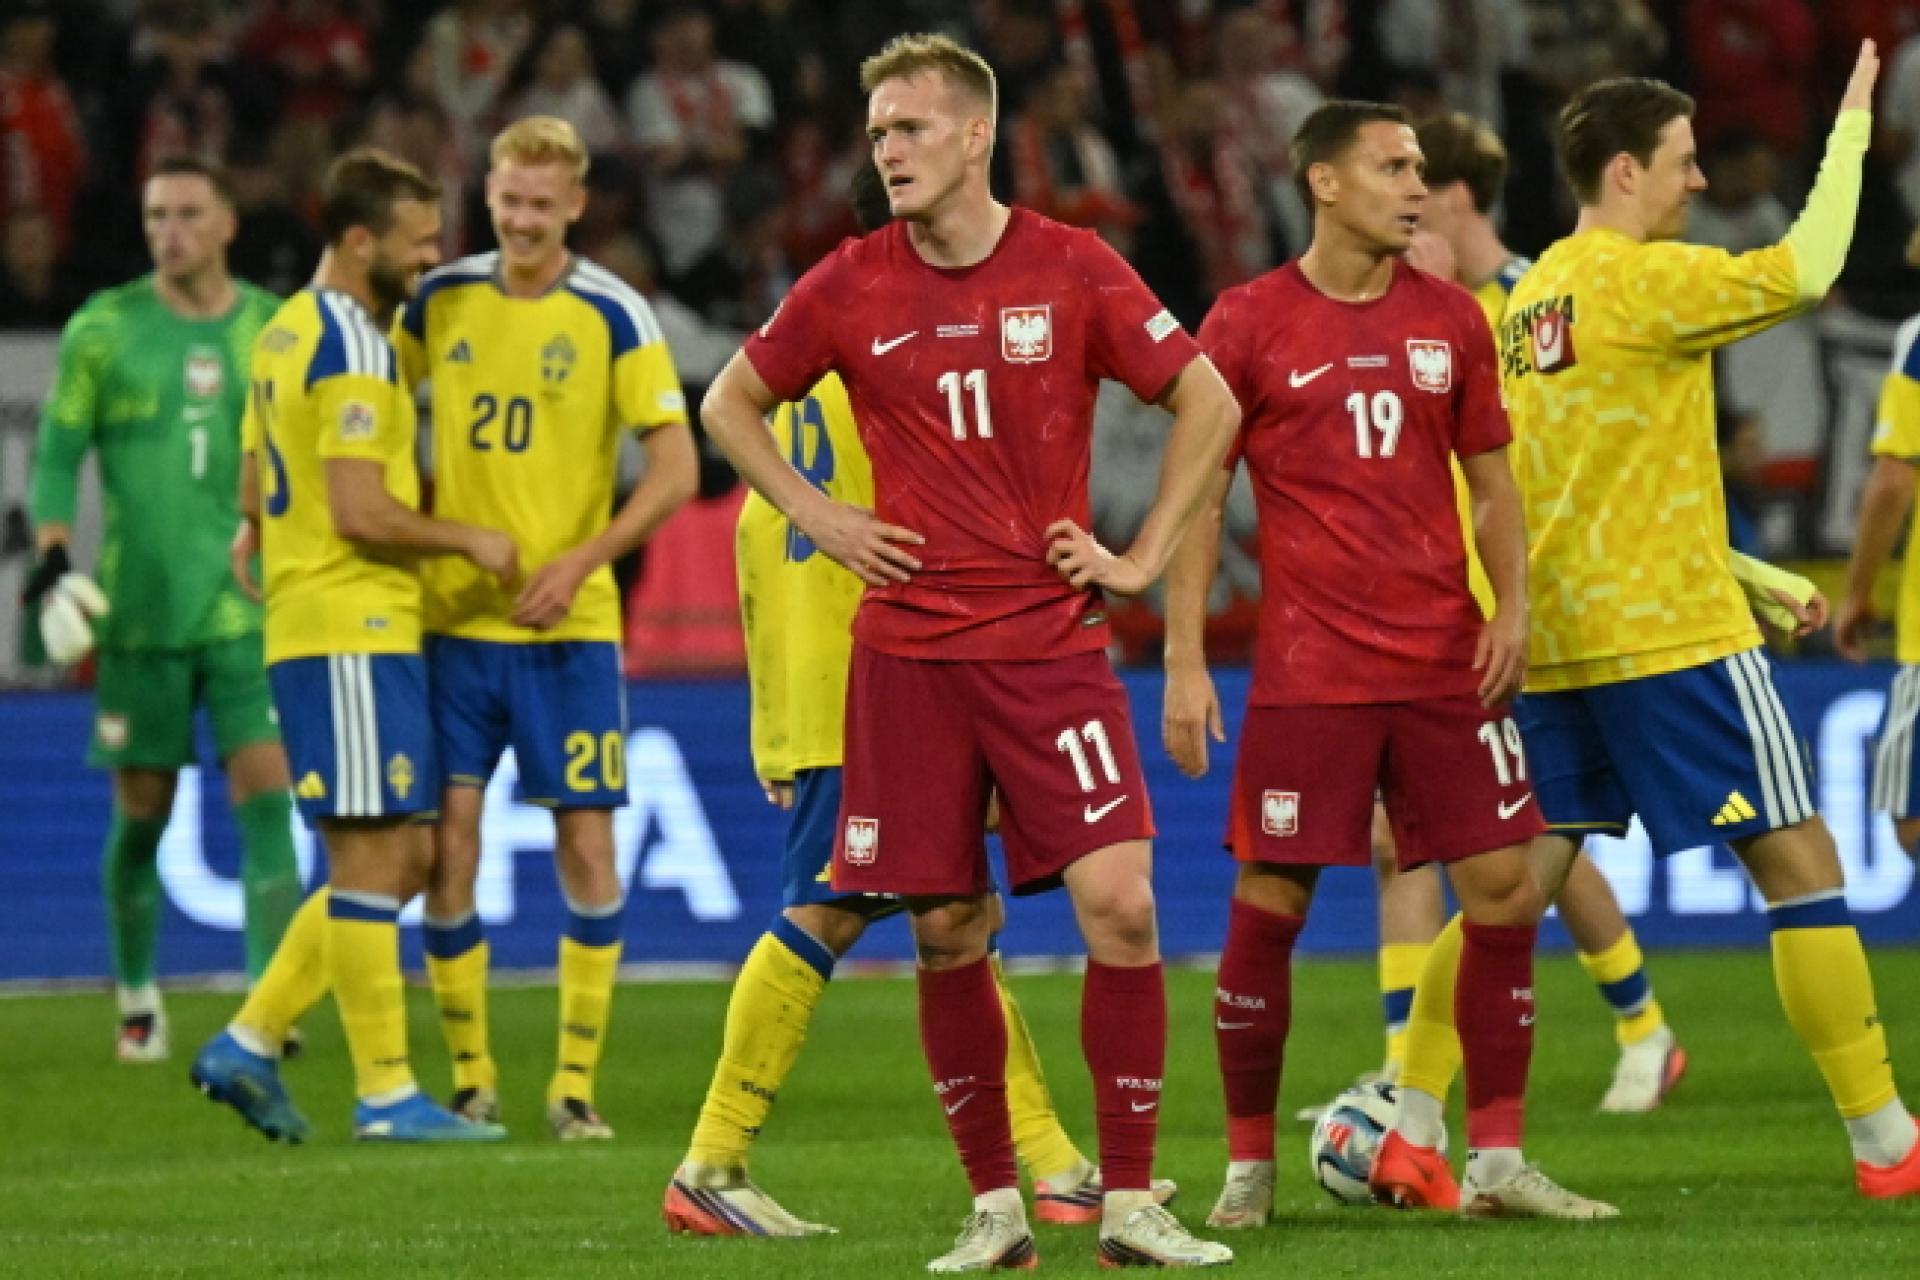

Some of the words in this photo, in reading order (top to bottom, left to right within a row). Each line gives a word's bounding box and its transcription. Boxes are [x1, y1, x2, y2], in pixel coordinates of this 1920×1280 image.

[469, 393, 533, 452] 20
[937, 369, 994, 441] 11
[1346, 390, 1402, 459] 19
[188, 426, 208, 478] 1
[564, 731, 625, 791] 20
[1056, 719, 1121, 793] 11
[1477, 716, 1526, 786] 19
[156, 727, 742, 929] UFA
